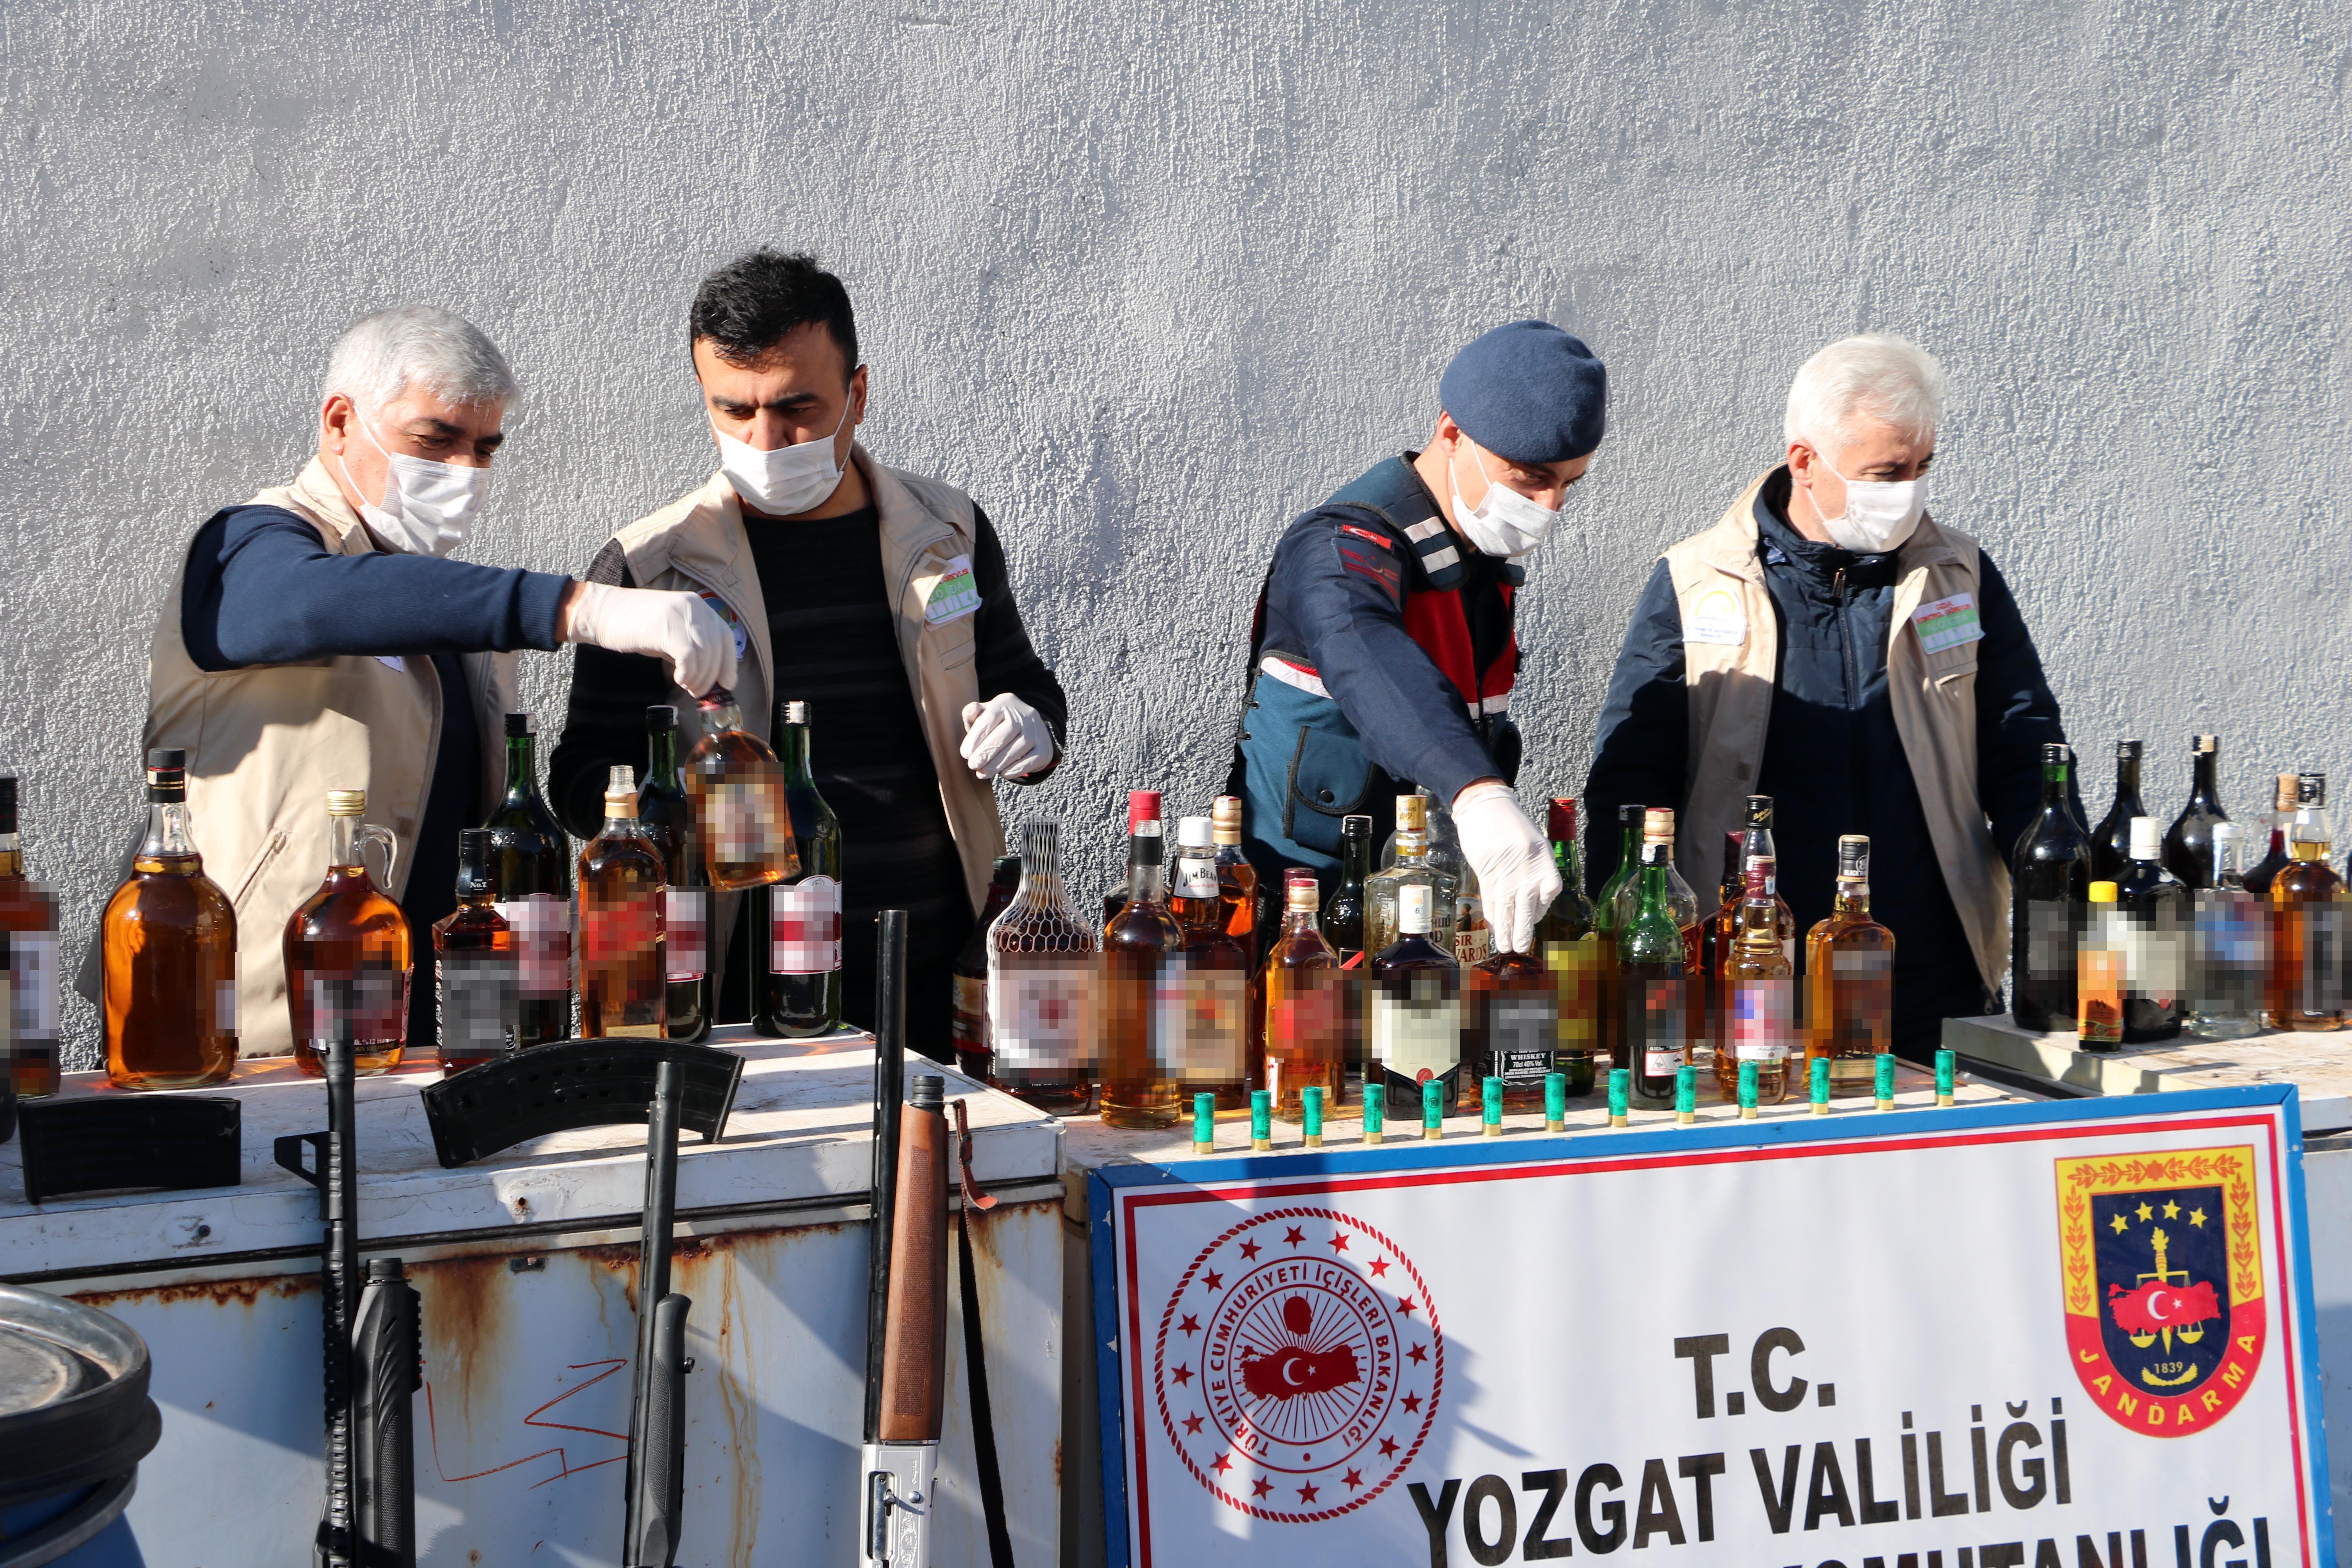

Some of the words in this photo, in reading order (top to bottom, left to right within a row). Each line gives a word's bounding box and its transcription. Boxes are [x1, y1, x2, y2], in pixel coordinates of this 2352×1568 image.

[1183, 871, 1198, 887] JIM
[1456, 935, 1472, 946] SIR
[1210, 1263, 1307, 1371] CUMHURİYETİ
[1315, 1264, 1386, 1329] İÇİŞLERİ
[1342, 1335, 1391, 1447] BAKANLIĞI
[1674, 1327, 1836, 1419] T.C.
[2080, 1335, 2256, 1425] JANDARMA
[2154, 1362, 2183, 1374] 1839
[1211, 1380, 1269, 1457] TÜRKİYE
[1406, 1452, 1726, 1568] YOZGAT
[1749, 1396, 2072, 1535] VALİLİĞİ
